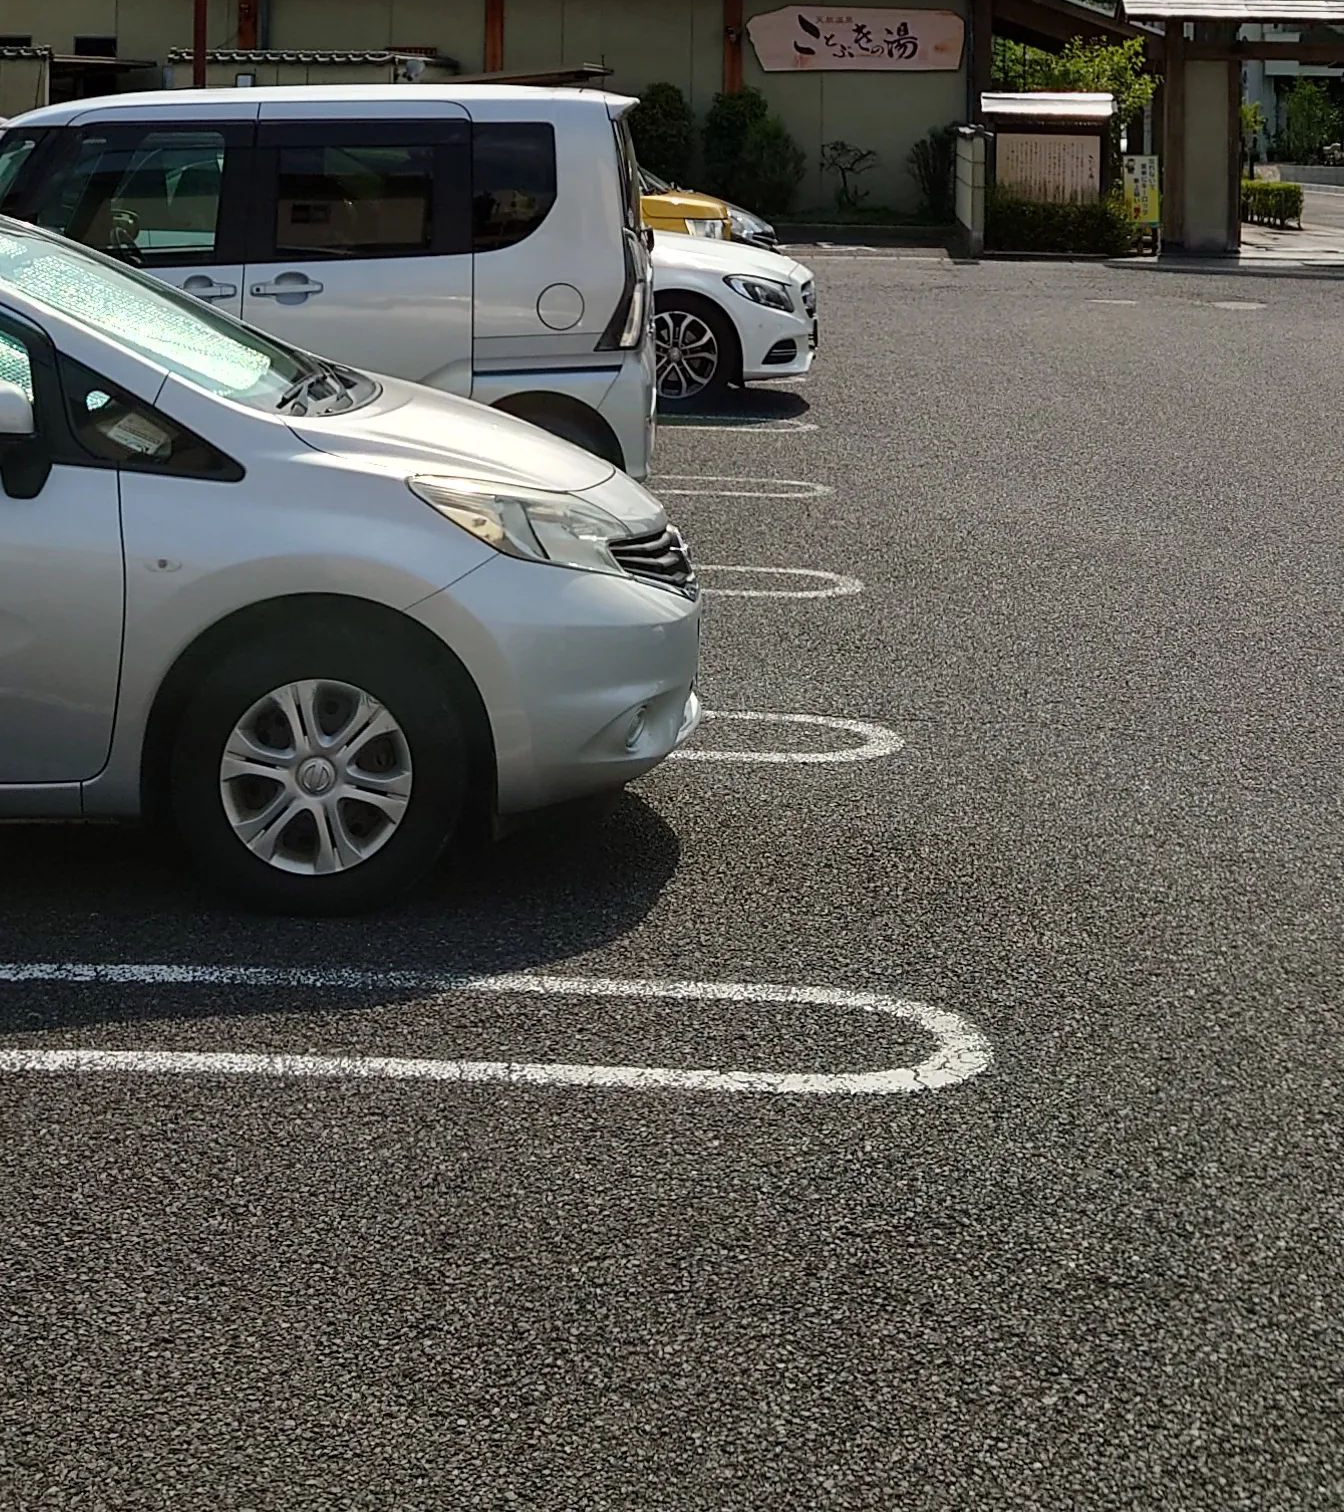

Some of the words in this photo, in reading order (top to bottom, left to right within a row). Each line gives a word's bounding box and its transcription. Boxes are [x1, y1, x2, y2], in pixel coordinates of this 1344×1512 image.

[793, 13, 919, 61] ことぶきの湯
